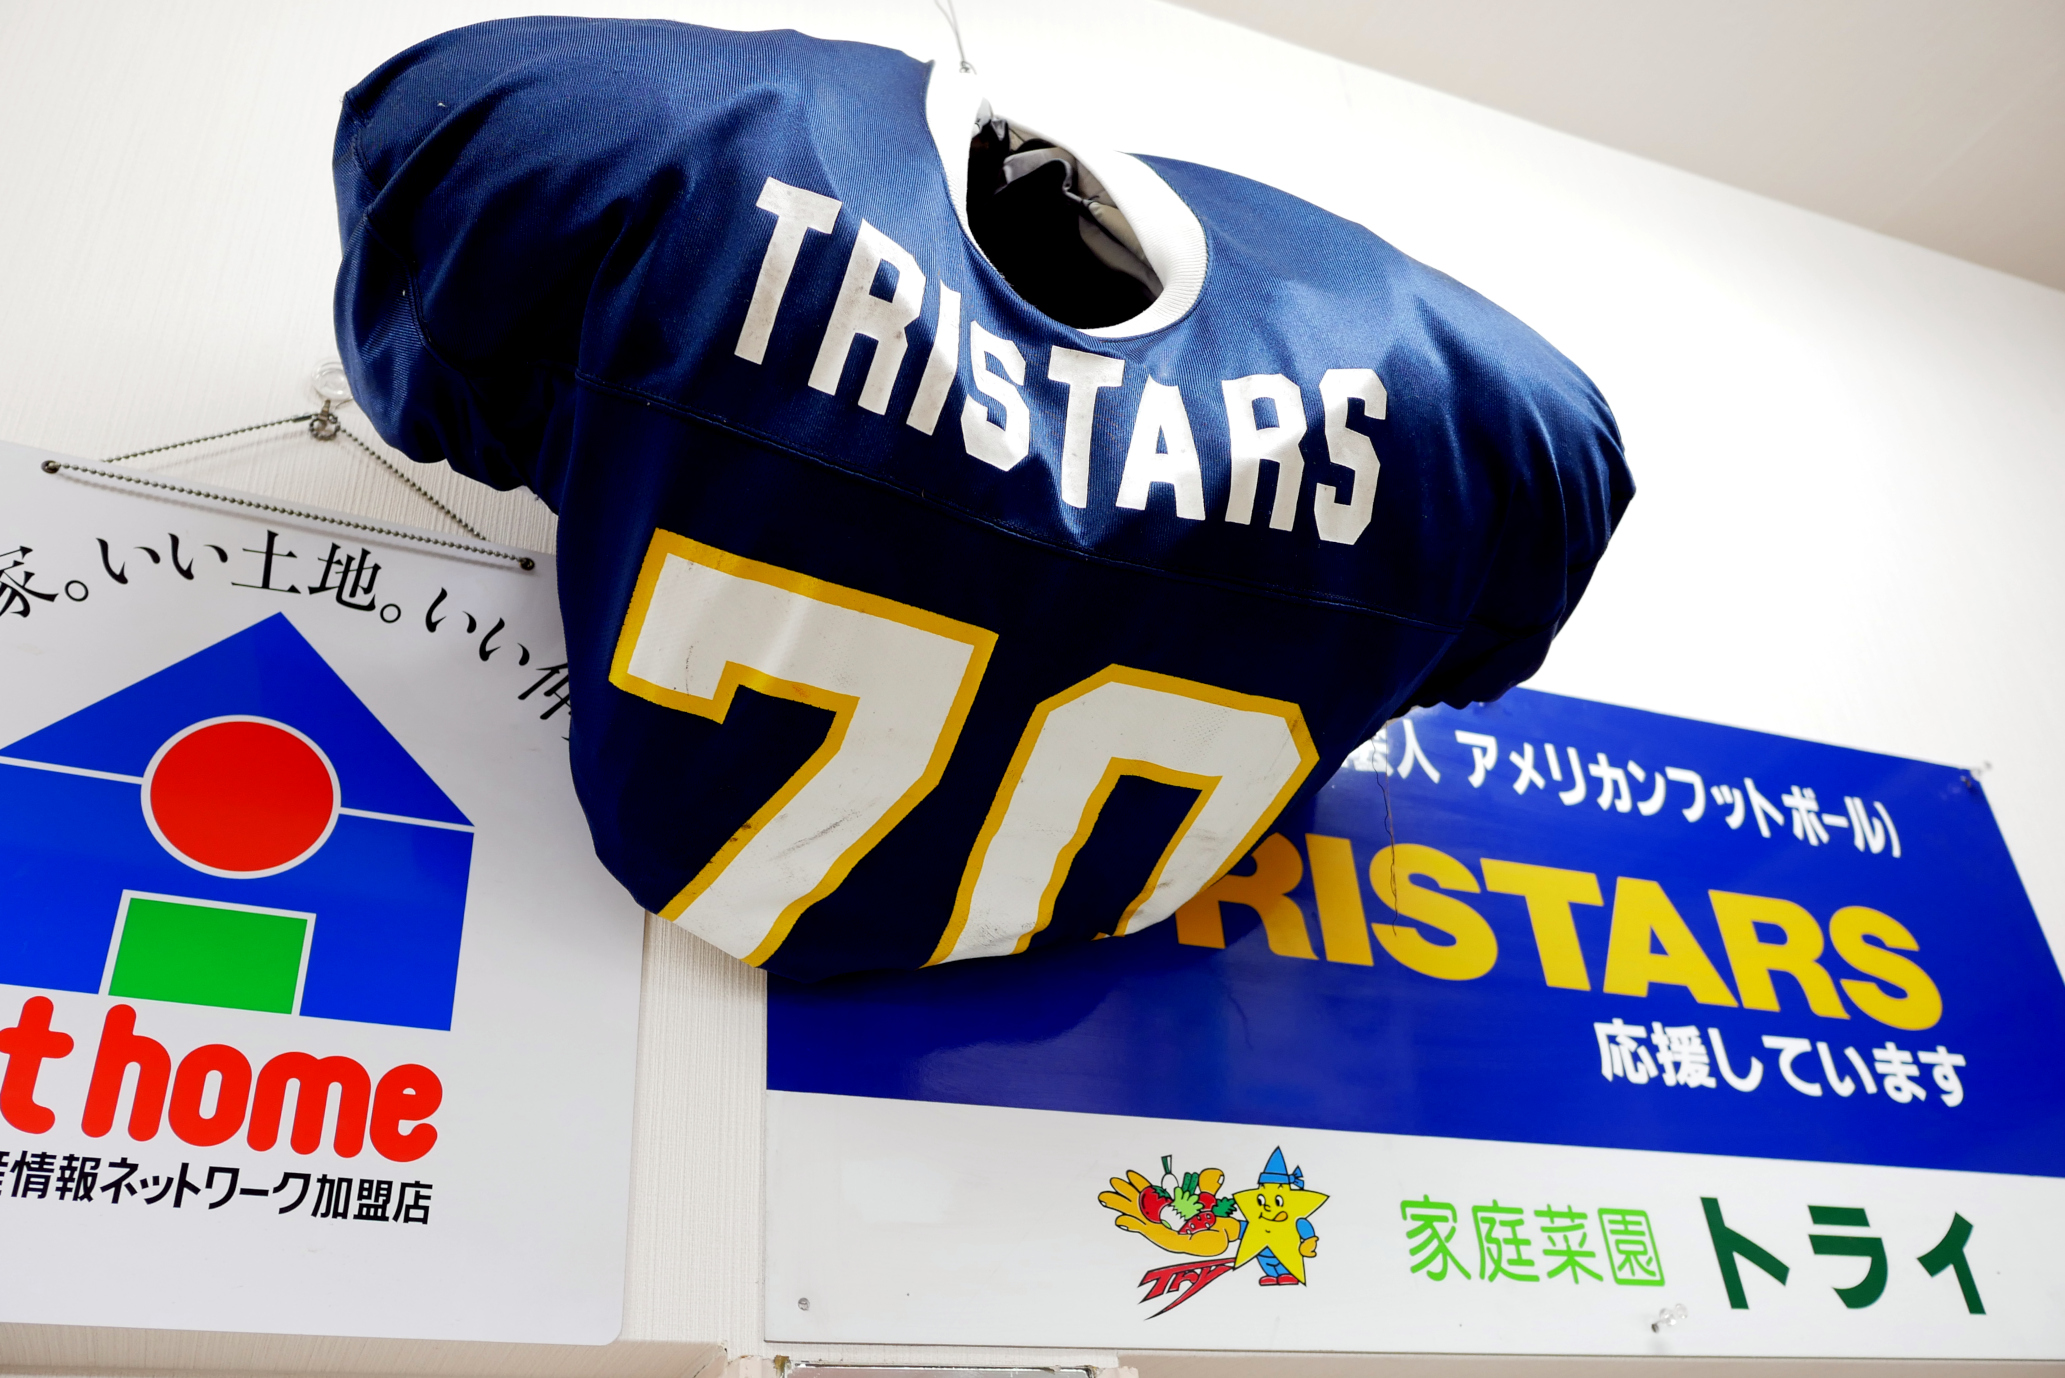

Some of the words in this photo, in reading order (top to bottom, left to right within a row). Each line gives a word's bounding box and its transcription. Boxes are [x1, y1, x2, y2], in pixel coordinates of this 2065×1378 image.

[734, 176, 1387, 546] TRISTARS
[609, 527, 1320, 969] 70
[81, 1003, 443, 1163] home
[1593, 1017, 1967, 1108] 応援しています
[0, 1150, 434, 1225] 情報ネットワーク加盟店
[1137, 1257, 1235, 1321] Try
[1400, 1194, 1665, 1287] 家庭菜園
[1701, 1196, 1987, 1316] トライ
